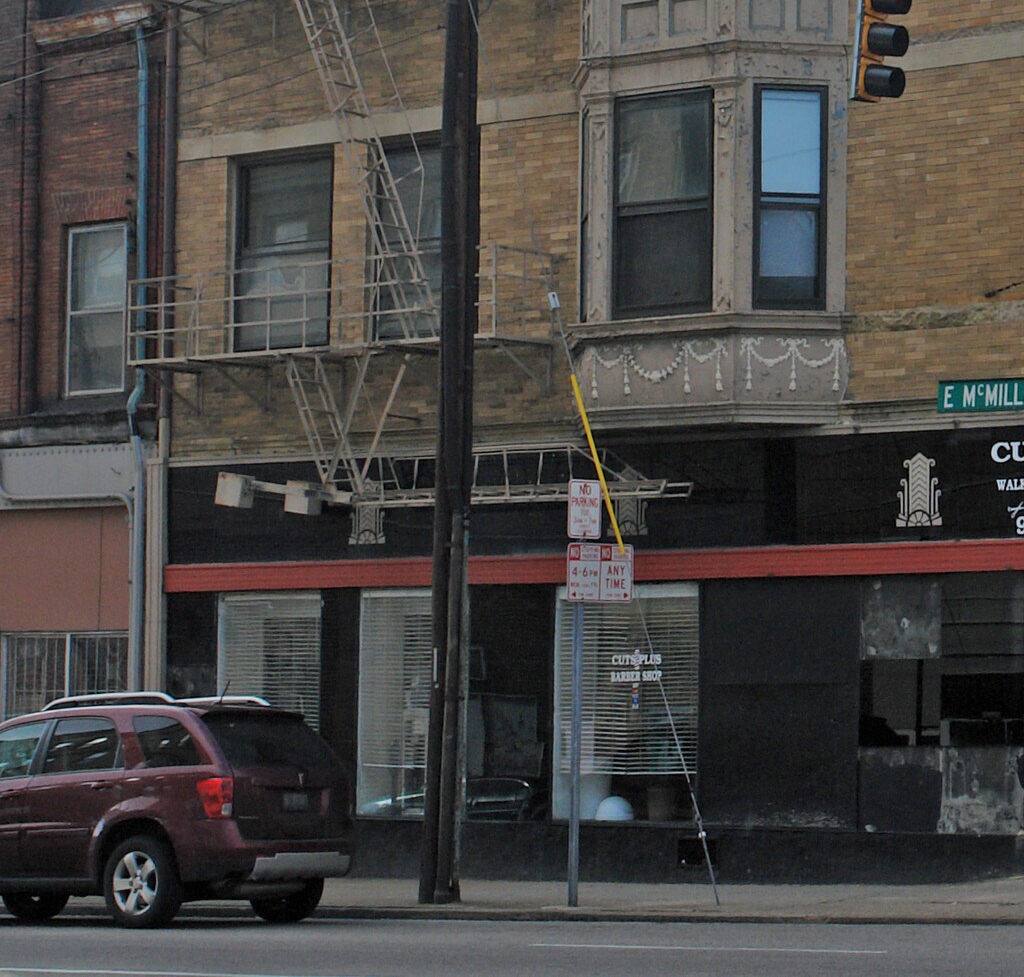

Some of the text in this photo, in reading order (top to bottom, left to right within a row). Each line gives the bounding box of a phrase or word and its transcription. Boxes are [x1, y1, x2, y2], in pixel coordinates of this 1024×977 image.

[943, 385, 955, 409] E
[579, 484, 592, 496] NO
[607, 565, 625, 576] ANY
[605, 578, 626, 590] TIME
[611, 653, 662, 665] CUTS PLUS
